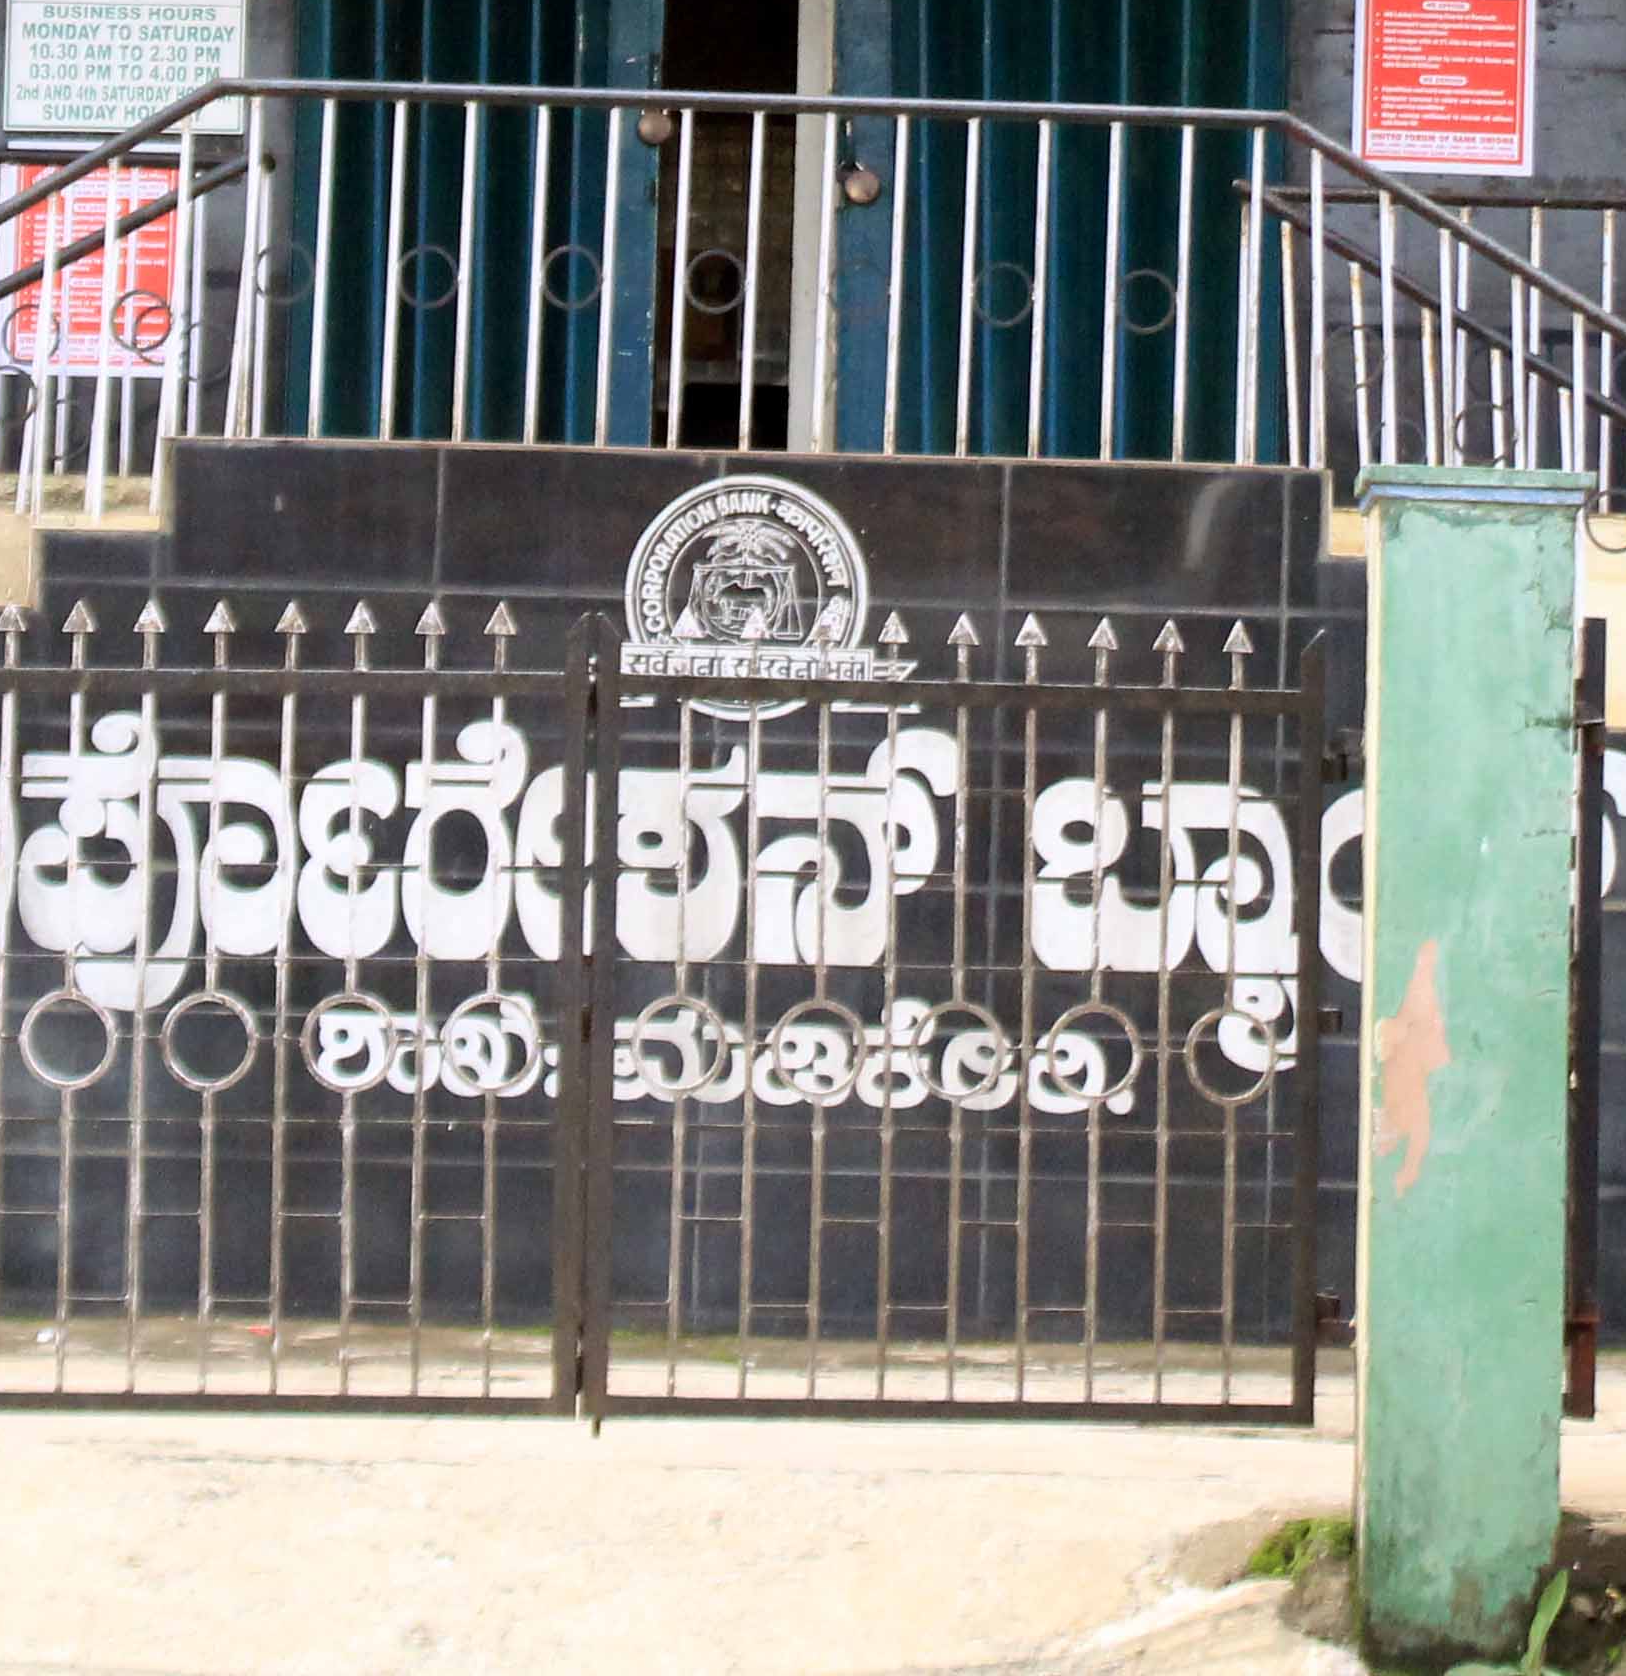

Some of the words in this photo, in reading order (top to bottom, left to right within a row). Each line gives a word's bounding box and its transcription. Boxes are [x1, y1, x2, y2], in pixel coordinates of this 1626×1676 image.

[42, 5, 142, 21] BUSINESS
[148, 7, 217, 22] HOURS
[23, 22, 101, 40] MONDAY
[108, 24, 132, 41] TO
[139, 26, 235, 42] SATURDAY
[29, 43, 78, 60] 10.30
[84, 44, 112, 61] AM
[118, 45, 143, 61] TO
[150, 46, 187, 62] 2.30
[194, 46, 221, 62] PM
[29, 63, 78, 80] 03.00
[85, 64, 111, 81] PM
[118, 65, 143, 81] TO
[149, 66, 187, 82] 4.00
[194, 66, 221, 81] PM
[16, 84, 39, 101] 2nd
[44, 84, 72, 101] AND
[76, 85, 97, 102] 4th
[101, 85, 170, 102] SATURDAY
[42, 104, 117, 122] SUNDAY
[641, 500, 717, 634] CORPORATION
[717, 490, 772, 516] BANK
